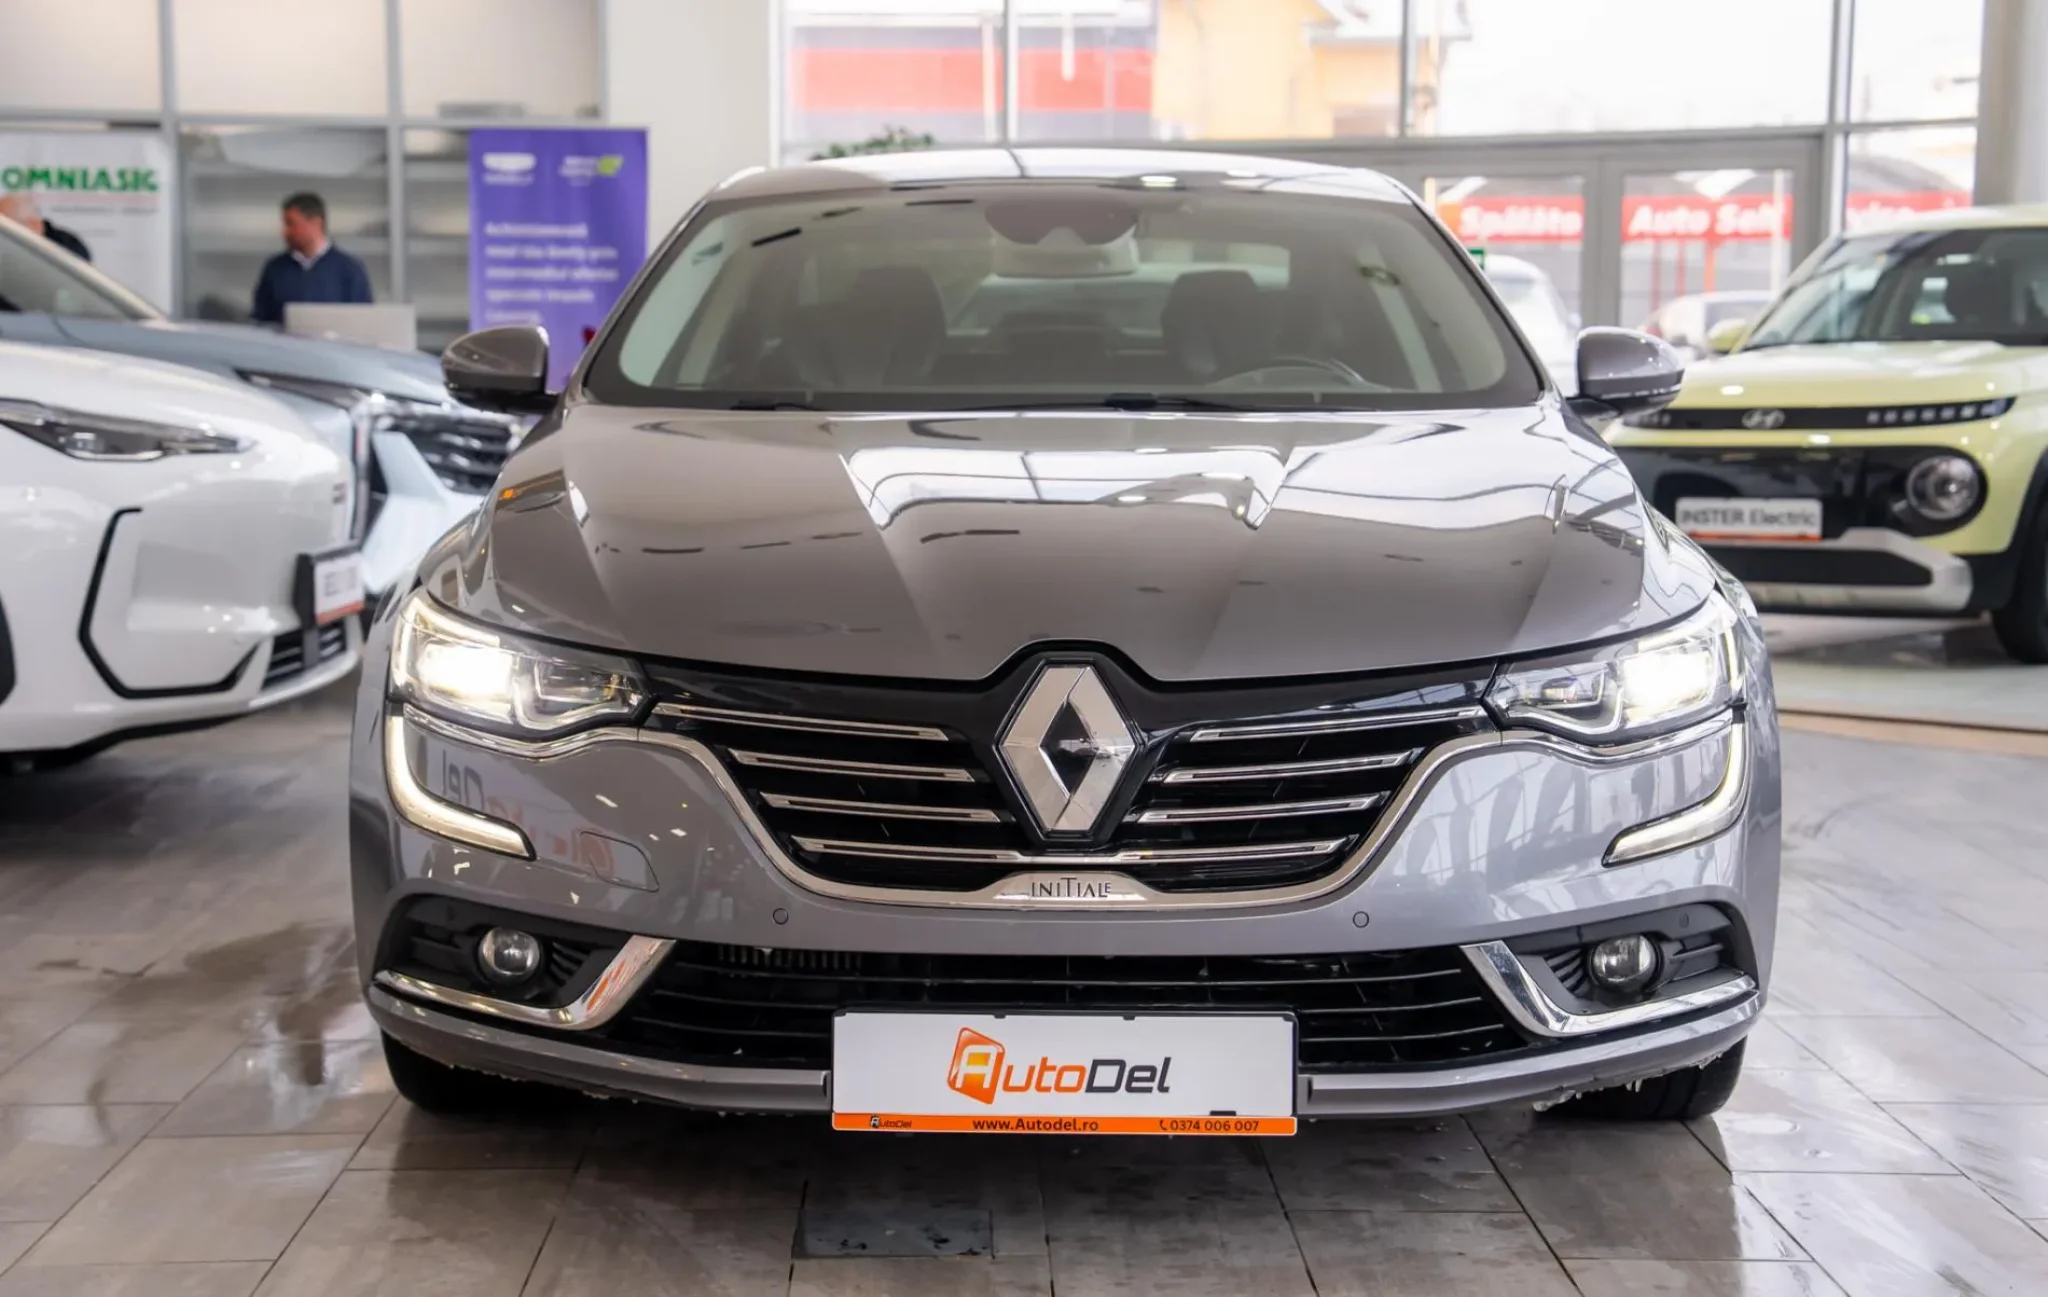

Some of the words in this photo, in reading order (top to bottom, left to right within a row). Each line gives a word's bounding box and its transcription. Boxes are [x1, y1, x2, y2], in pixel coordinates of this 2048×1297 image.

[1629, 205, 1710, 235] Auto
[1750, 508, 1816, 527] Electric
[1032, 877, 1112, 898] INITIALE
[947, 1038, 1171, 1097] AutoDel
[973, 1118, 1099, 1132] www.Autodel.ro
[1170, 1121, 1201, 1131] 0374
[1204, 1121, 1232, 1131] 006
[1234, 1121, 1260, 1131] 007
